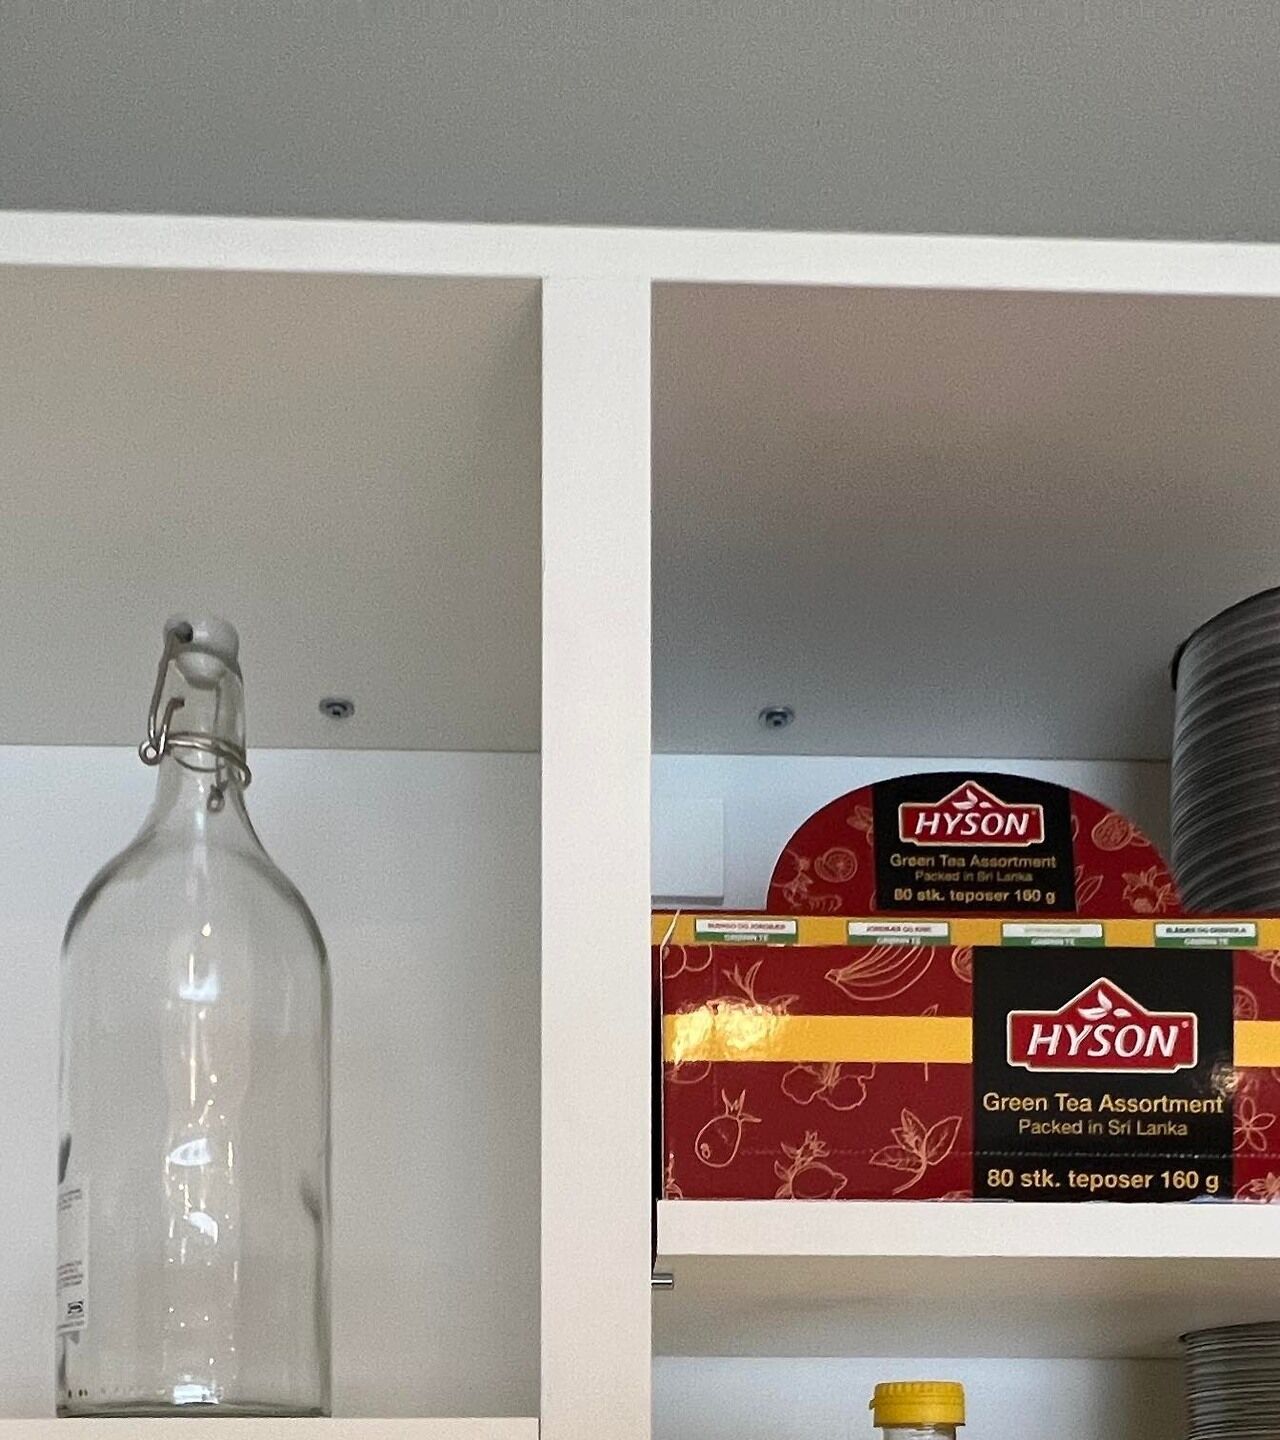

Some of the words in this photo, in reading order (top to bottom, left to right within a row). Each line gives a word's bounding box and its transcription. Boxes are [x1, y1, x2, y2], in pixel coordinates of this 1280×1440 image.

[914, 812, 1030, 836] HYSON
[889, 853, 935, 868] Green
[939, 854, 966, 868] Tea
[969, 854, 1057, 869] Assortment
[914, 871, 961, 882] Packed
[963, 871, 974, 882] in
[976, 871, 993, 882] Sri
[996, 871, 1034, 883] Lanka
[893, 888, 913, 901] 80
[950, 889, 1010, 904] teposer
[1014, 889, 1041, 901] 160
[1045, 891, 1057, 905] g
[1026, 1023, 1179, 1058] HYSON
[982, 1092, 1048, 1112] Green
[1054, 1093, 1093, 1113] Tea
[1098, 1094, 1224, 1114] Assortment
[1018, 1118, 1083, 1135] Packed
[1088, 1119, 1103, 1135] in
[1108, 1119, 1132, 1136] Sri
[1136, 1120, 1188, 1136] Lanka
[987, 1168, 1014, 1188] 80
[1020, 1169, 1061, 1188] stk.
[1068, 1170, 1153, 1193] teposer
[1160, 1171, 1199, 1189] 160
[1205, 1174, 1219, 1194] g
